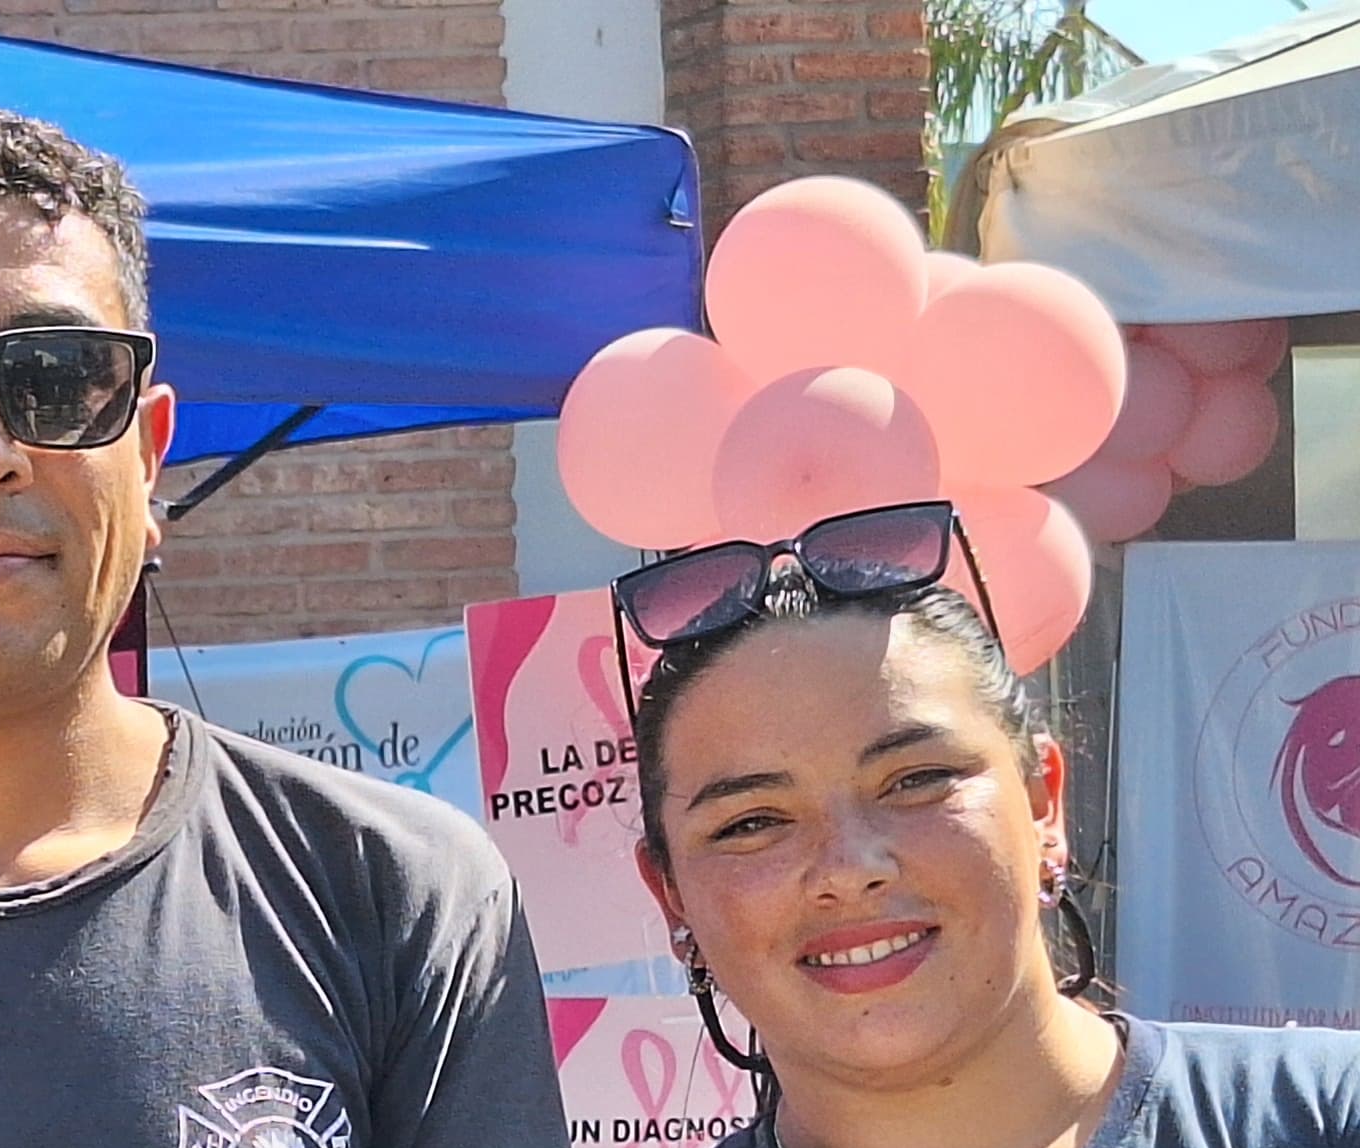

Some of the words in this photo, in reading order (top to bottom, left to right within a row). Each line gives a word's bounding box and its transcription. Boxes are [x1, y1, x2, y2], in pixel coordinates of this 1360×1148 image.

[241, 716, 322, 744] dación
[380, 721, 420, 768] de
[541, 744, 583, 776] LA
[595, 738, 638, 768] DE
[491, 777, 627, 821] PRECOZ
[613, 1117, 755, 1143] DIAGNOS
